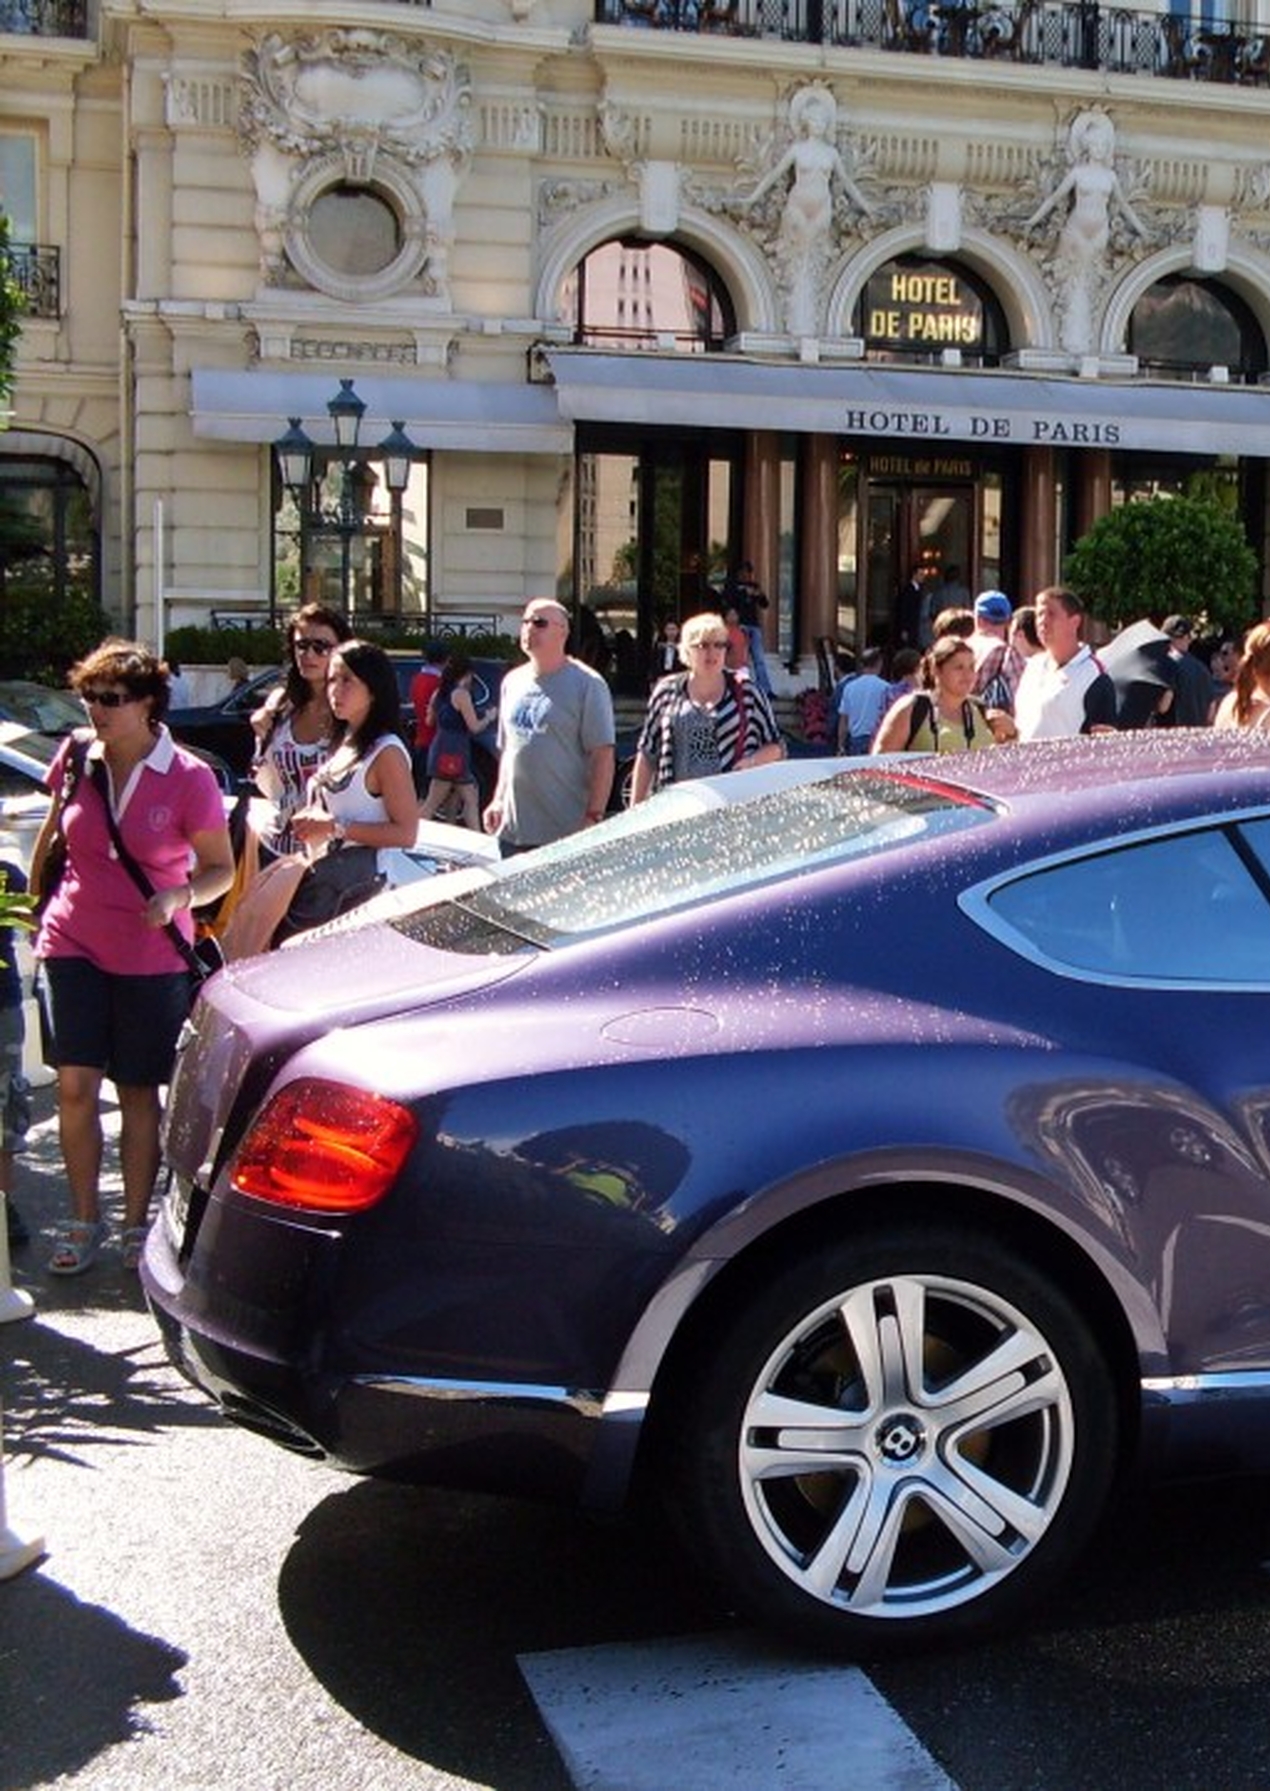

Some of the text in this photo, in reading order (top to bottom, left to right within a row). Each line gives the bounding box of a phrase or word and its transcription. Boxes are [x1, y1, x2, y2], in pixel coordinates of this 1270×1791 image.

[891, 274, 962, 305] HOTEL
[870, 310, 976, 344] DE PARIS
[846, 410, 1121, 444] HOTEL DE PARIS
[869, 456, 911, 474] HOTEL
